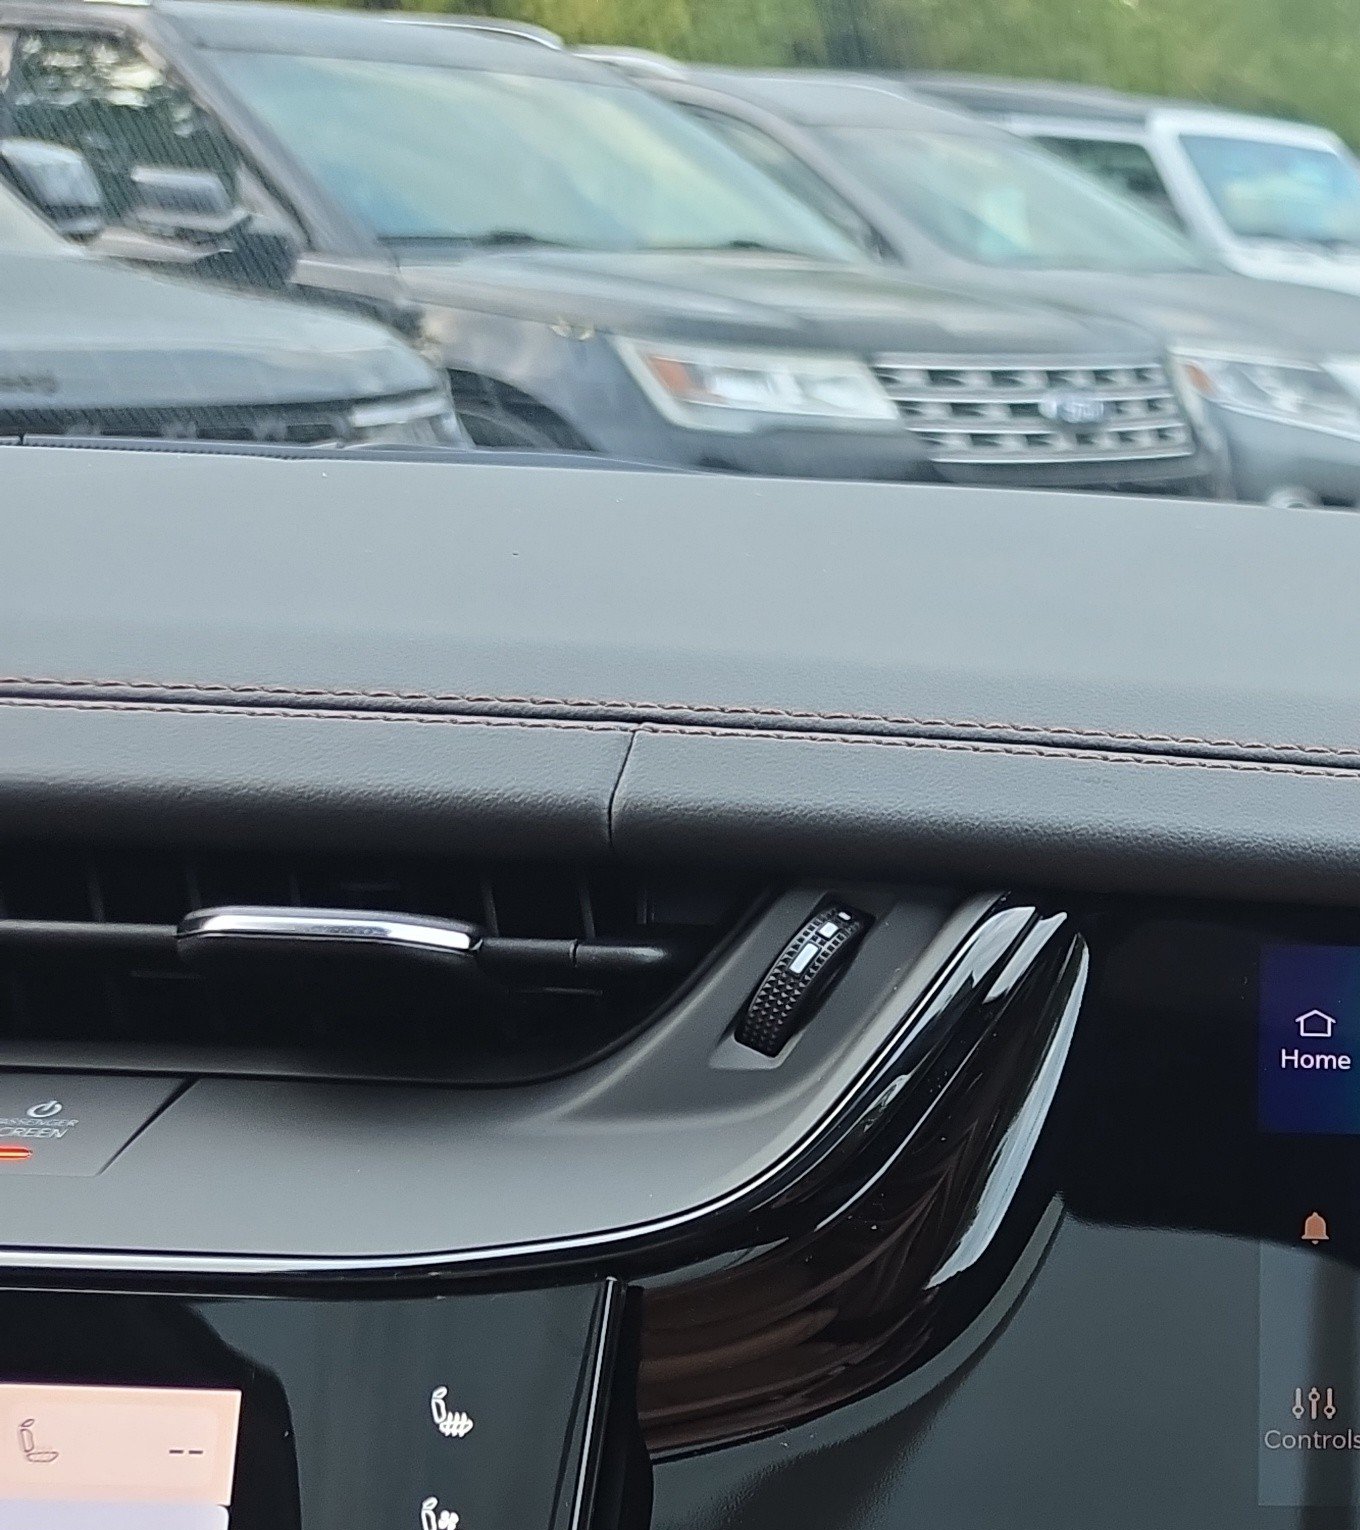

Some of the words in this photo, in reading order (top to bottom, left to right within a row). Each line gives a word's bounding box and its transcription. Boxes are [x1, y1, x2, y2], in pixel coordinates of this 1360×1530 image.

[1280, 1049, 1352, 1071] Home
[0, 1118, 79, 1127] ASSENGER
[0, 1127, 68, 1138] CREEN
